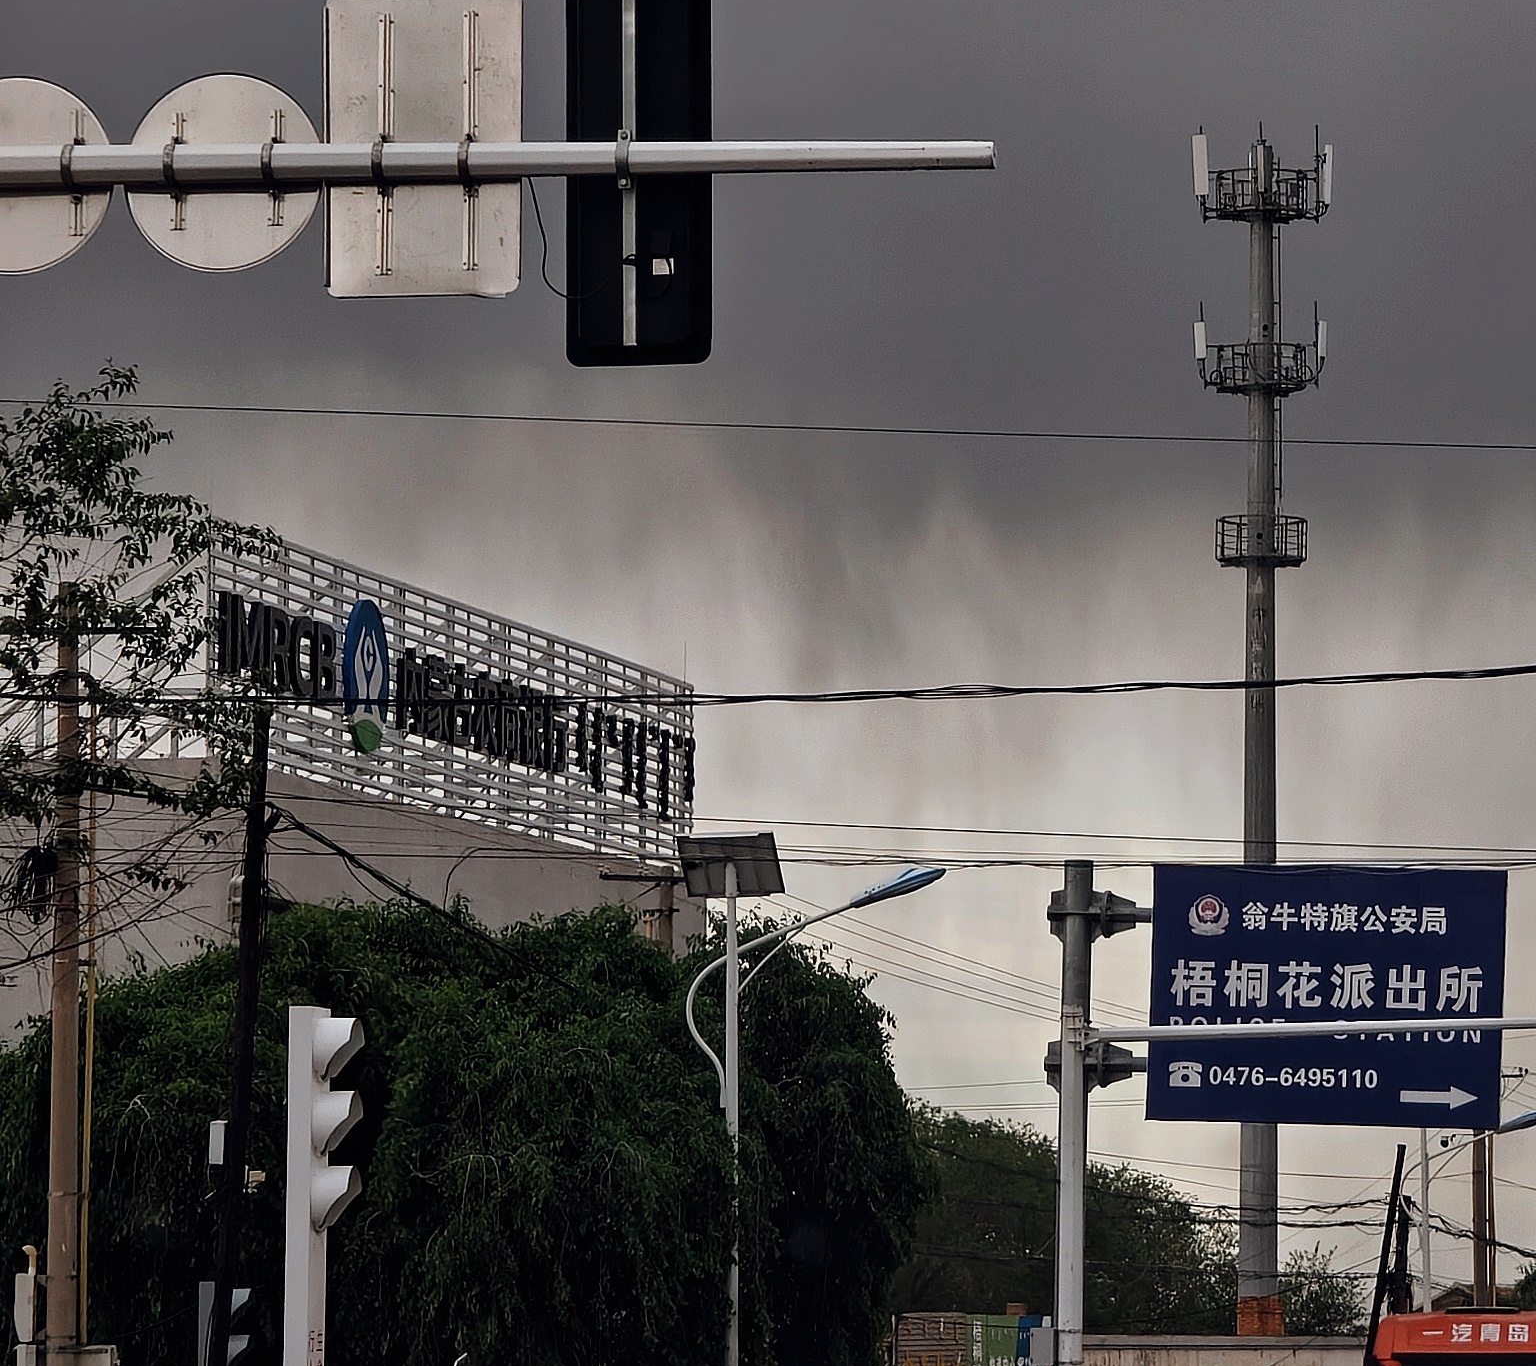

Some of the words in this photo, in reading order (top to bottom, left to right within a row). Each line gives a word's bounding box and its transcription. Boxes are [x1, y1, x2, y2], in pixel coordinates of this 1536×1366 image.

[1241, 901, 1447, 935] 翁牛特旗公安局
[1169, 958, 1483, 1014] 梧桐花派出所
[1208, 1066, 1378, 1089] 0476-6495110
[1422, 1323, 1529, 1343] 一汽青岛
